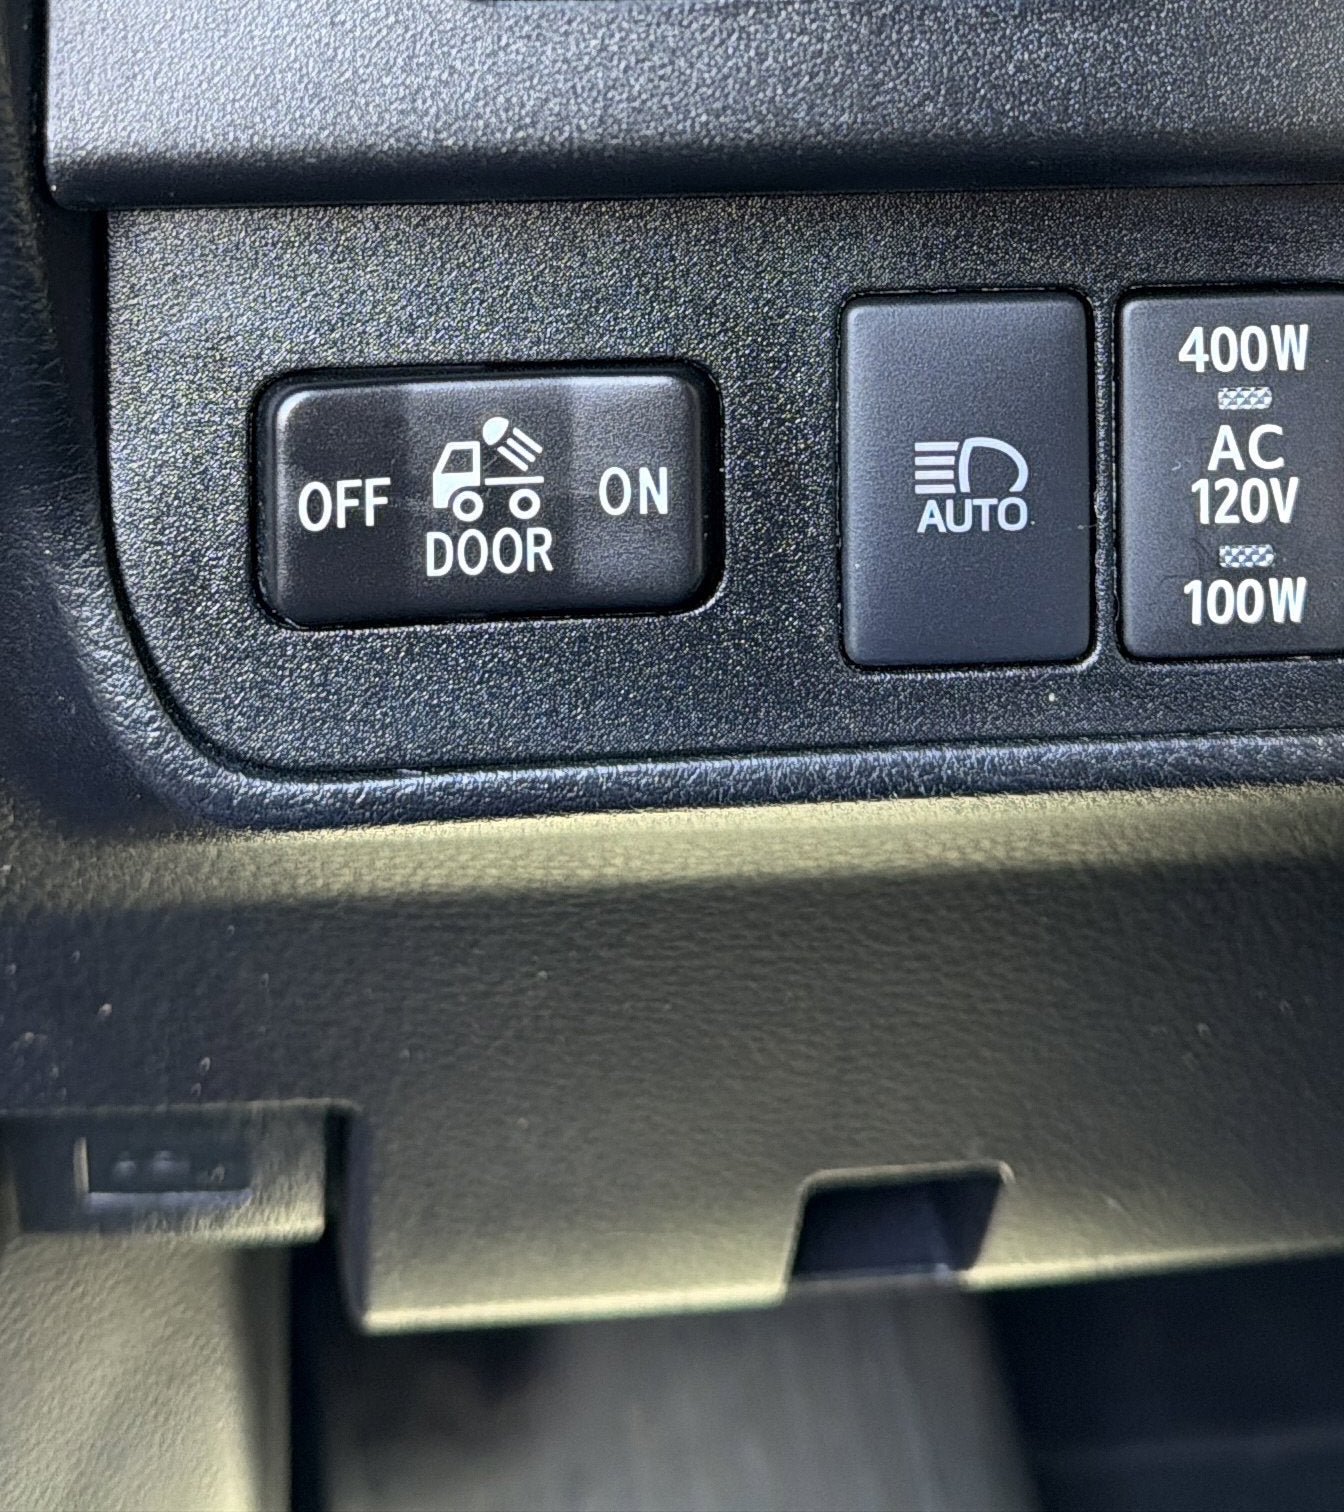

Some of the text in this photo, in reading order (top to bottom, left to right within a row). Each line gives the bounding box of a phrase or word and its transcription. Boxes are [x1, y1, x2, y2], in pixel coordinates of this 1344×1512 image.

[1178, 323, 1309, 373] 400W
[1207, 423, 1285, 471] AC
[298, 476, 391, 532] OFF
[598, 466, 669, 516] ON
[916, 496, 1028, 534] AUTO
[1191, 476, 1300, 525] 120V
[425, 526, 554, 577] DOOR
[1183, 576, 1308, 626] 100W
